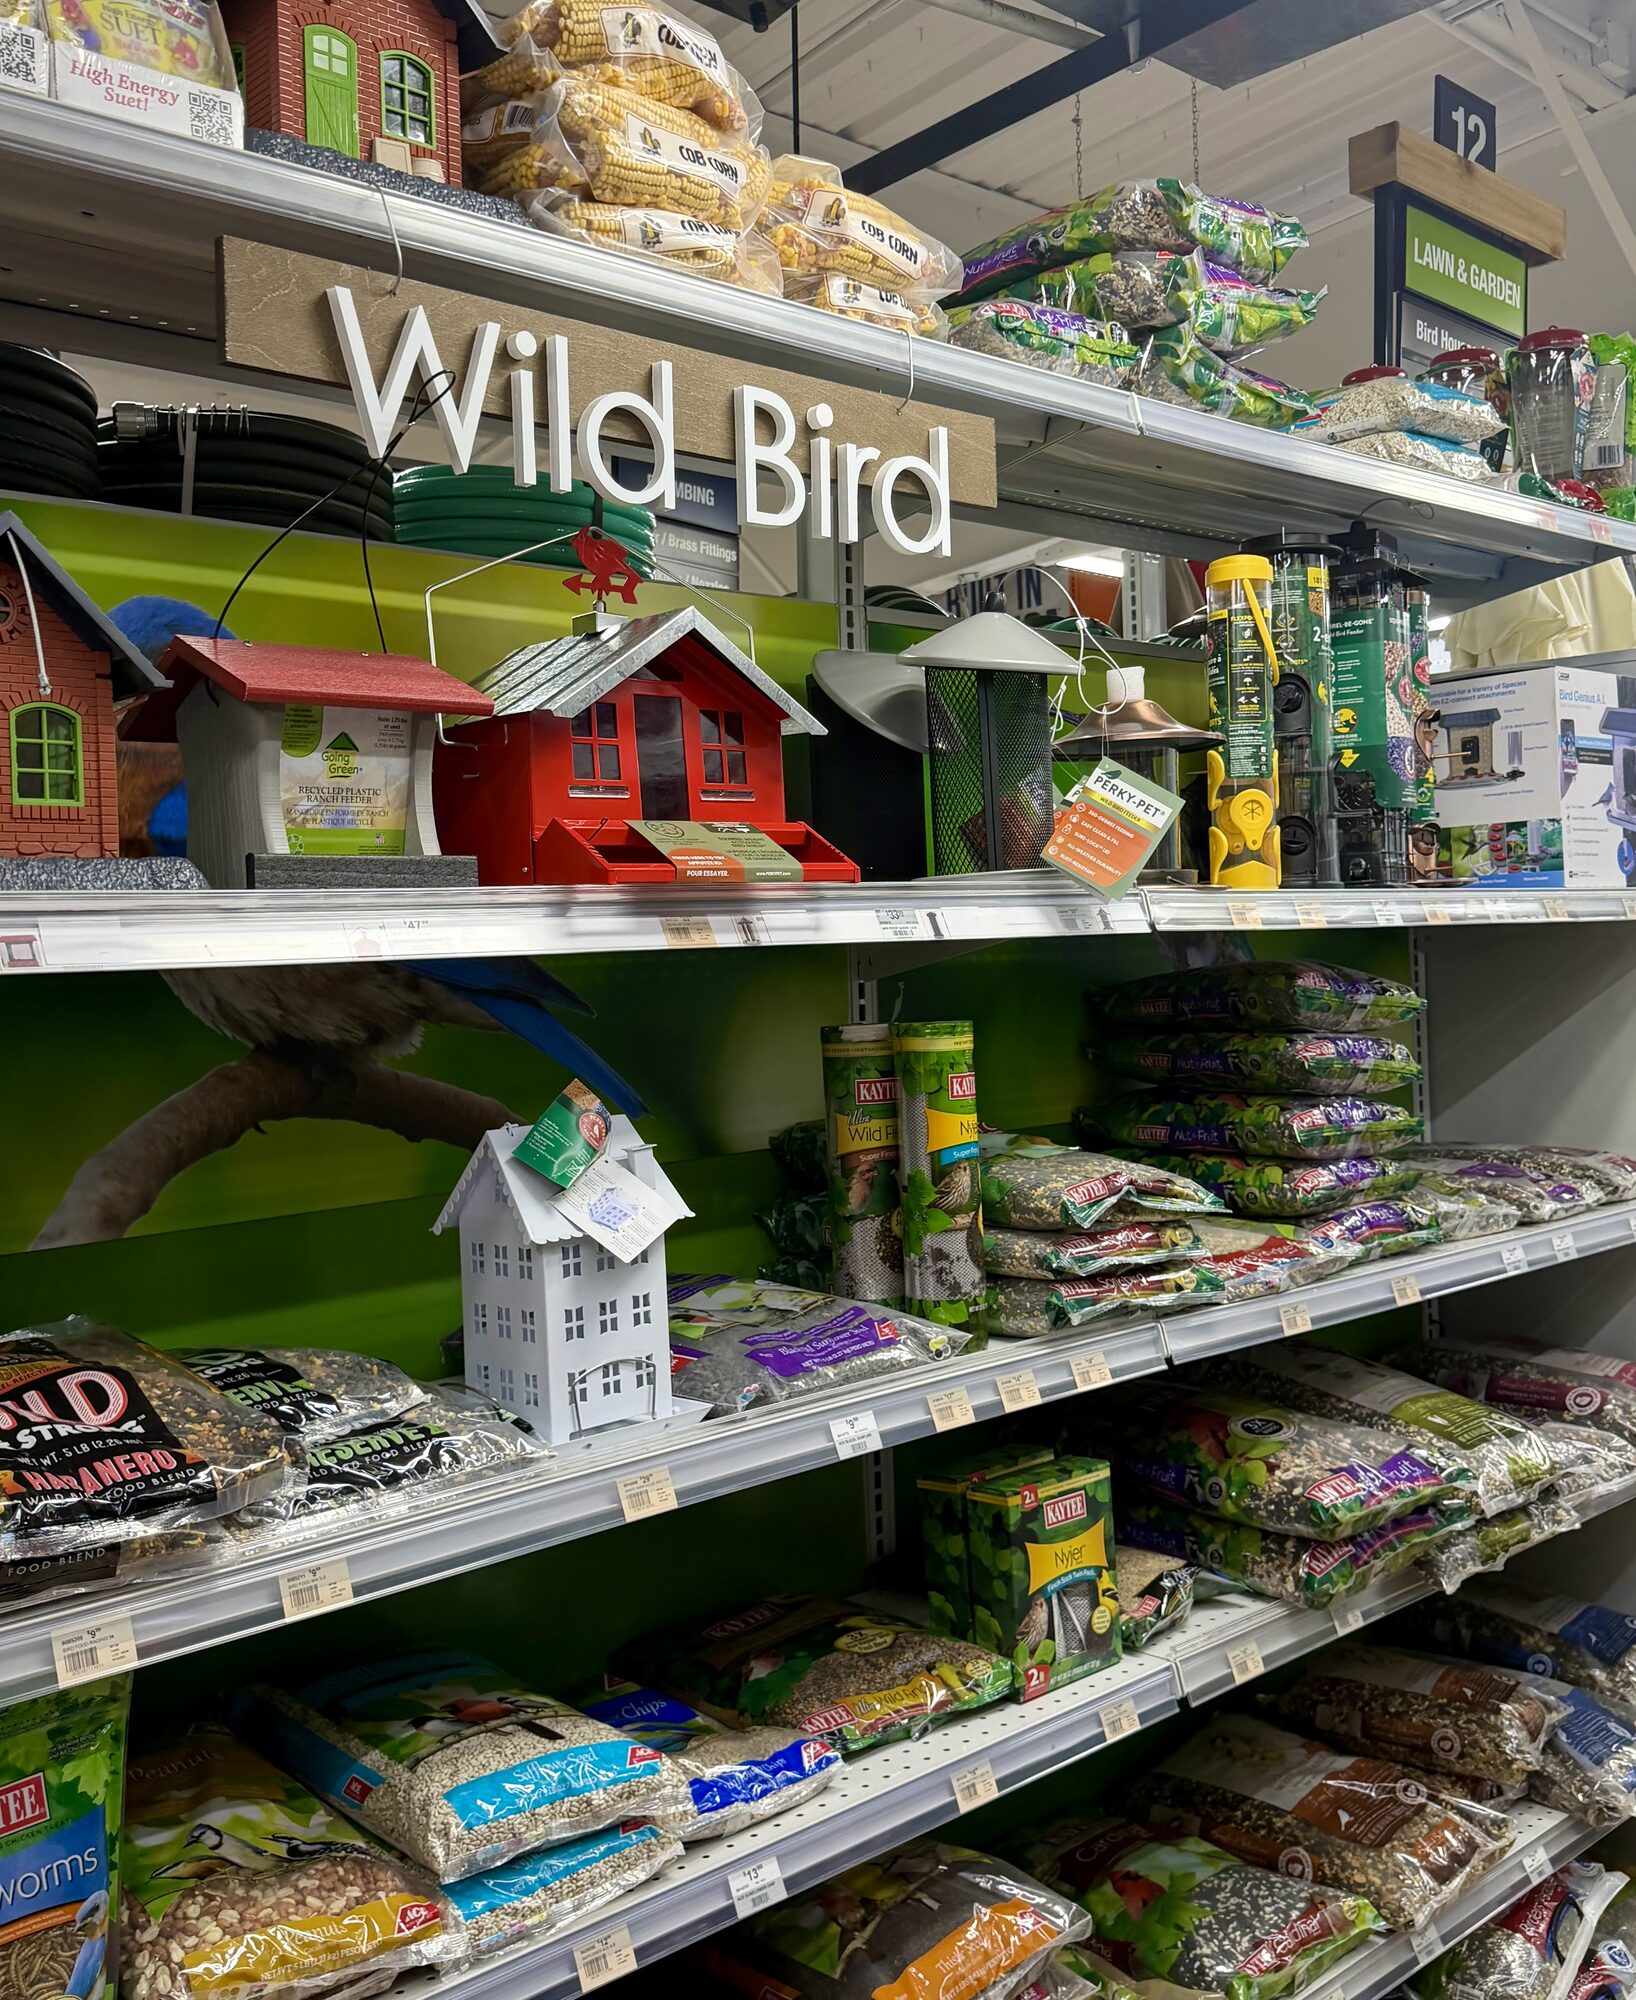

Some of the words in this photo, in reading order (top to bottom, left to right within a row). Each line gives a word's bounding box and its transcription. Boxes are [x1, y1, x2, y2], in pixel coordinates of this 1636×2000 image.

[70, 60, 113, 86] High
[118, 73, 179, 106] Energy
[104, 87, 148, 111] Suet!
[1451, 106, 1486, 162] 12
[678, 144, 707, 168] COB
[708, 158, 740, 184] CORN
[861, 219, 886, 244] COB
[888, 234, 919, 266] CORN
[1414, 237, 1455, 279] LAWN
[1457, 264, 1467, 285] &
[1470, 265, 1521, 309] GARDEN
[1416, 319, 1438, 346] Bird
[325, 286, 677, 510] Wild
[733, 385, 951, 558] Bird
[668, 534, 698, 553] Brass
[700, 541, 738, 563] Fittings
[1559, 689, 1573, 701] Bird
[1574, 691, 1595, 703] Genius
[321, 752, 350, 766] Going
[328, 763, 360, 775] Green
[299, 786, 344, 795] RECYCLED
[346, 788, 382, 796] PLASTIC
[306, 795, 339, 804] RANCH
[341, 796, 372, 804] FEEDER
[848, 1126, 882, 1142] Wild
[1138, 1128, 1168, 1141] KAYTEE
[1174, 1130, 1191, 1142] Nut
[1197, 1128, 1219, 1142] Fruit
[1071, 1182, 1107, 1203] KAYTEE
[283, 1390, 319, 1405] BLEND
[40, 1452, 62, 1467] WT.
[73, 1443, 91, 1455] LB
[365, 1448, 399, 1465] FOOD
[105, 1480, 147, 1501] FOOD
[152, 1467, 196, 1485] BLEND
[1023, 1490, 1032, 1504] 2
[1047, 1496, 1084, 1524] KAYTEE
[7, 1559, 52, 1578] FOOD
[58, 1548, 107, 1566] BLEND
[1054, 1544, 1086, 1568] Nyjer
[1028, 1667, 1040, 1687] 2
[621, 1697, 668, 1720] Chips
[802, 1705, 852, 1733] KAYTEE
[567, 1747, 599, 1766] Seed
[5, 1829, 42, 1847] CHICKEN
